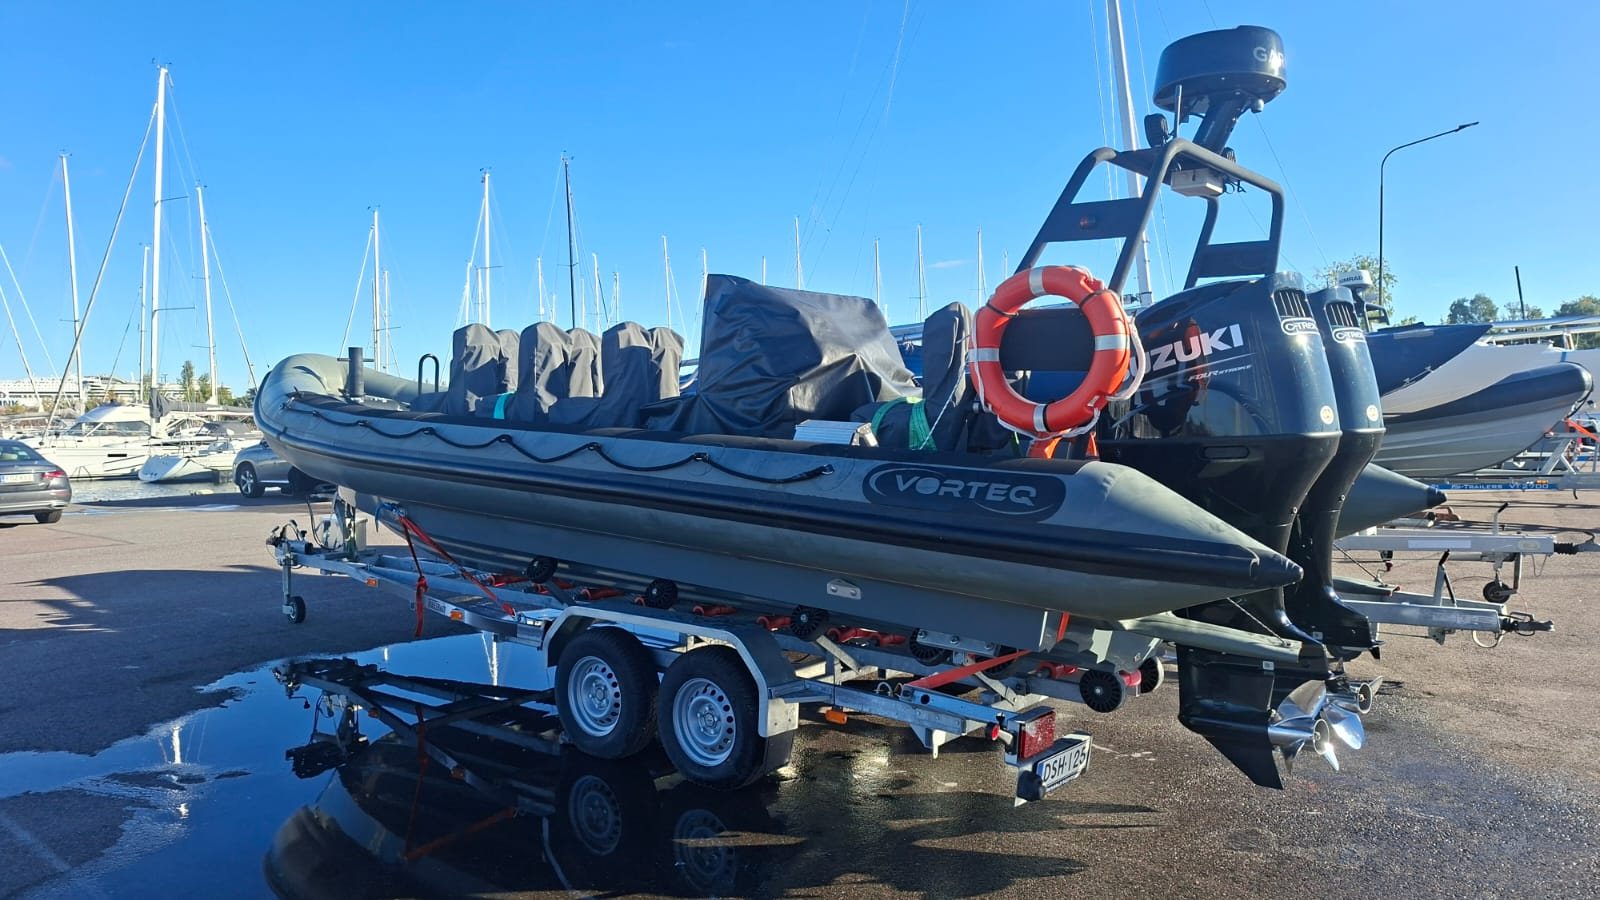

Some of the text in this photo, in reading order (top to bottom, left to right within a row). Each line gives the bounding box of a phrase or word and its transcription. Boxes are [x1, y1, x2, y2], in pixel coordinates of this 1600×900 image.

[1123, 324, 1244, 381] UZUKI
[896, 474, 1037, 507] VORTEQ
[1043, 746, 1086, 782] DSH-125
